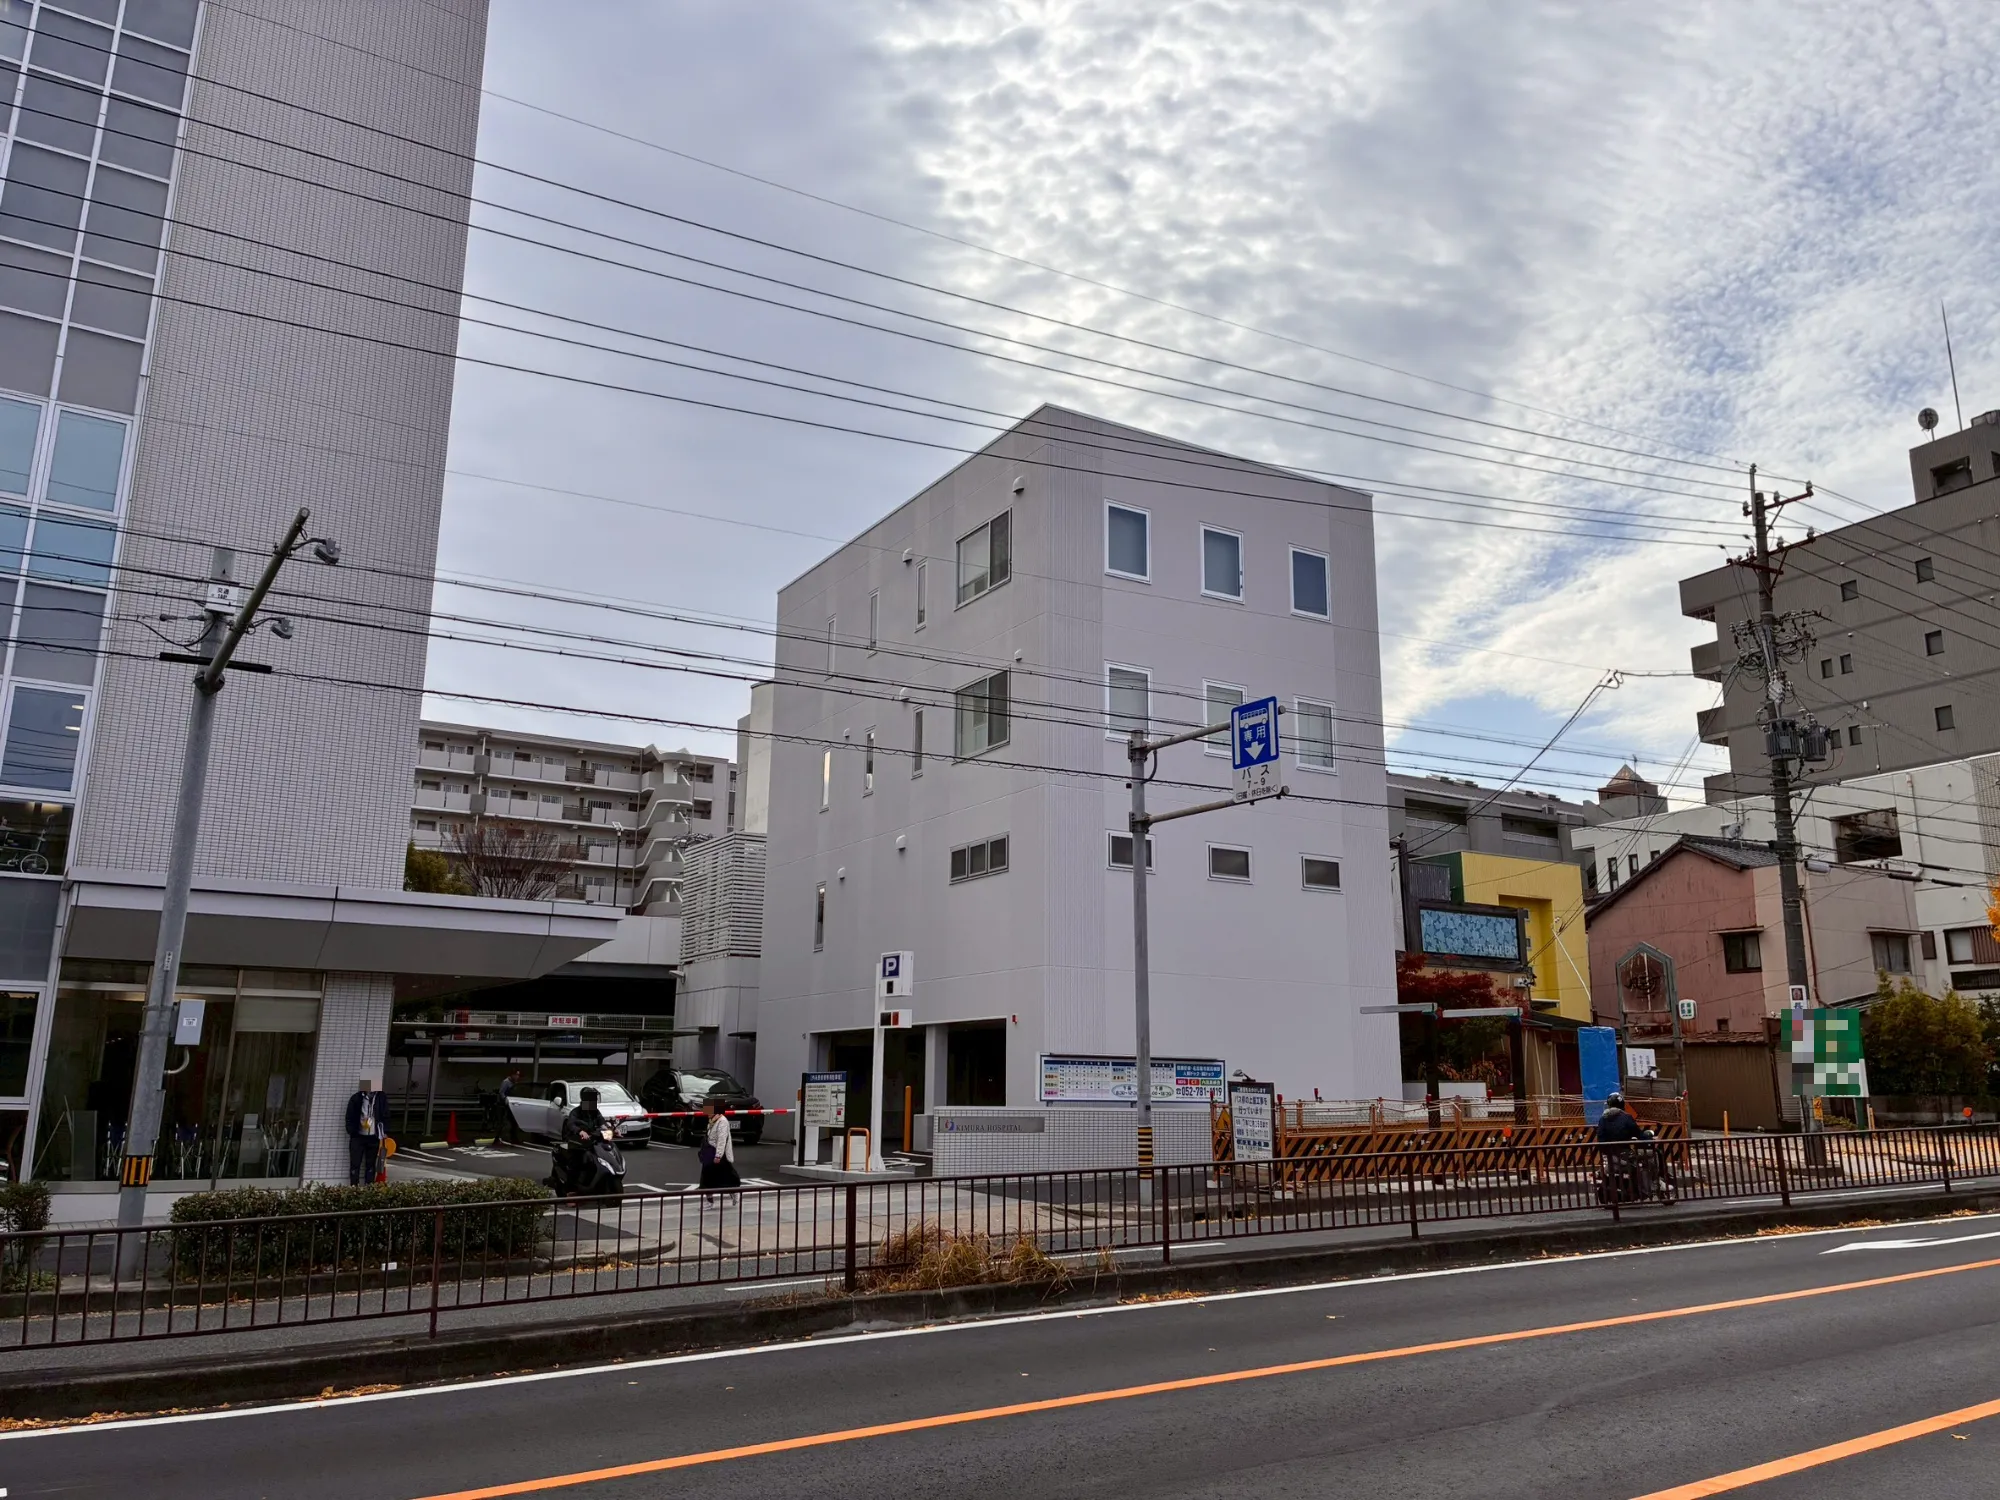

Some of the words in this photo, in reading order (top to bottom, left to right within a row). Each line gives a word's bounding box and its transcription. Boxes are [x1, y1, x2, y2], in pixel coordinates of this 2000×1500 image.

[1244, 725, 1266, 742] 専用
[1242, 764, 1270, 780] バス
[886, 957, 897, 976] P
[956, 1124, 985, 1132] KIMURA
[987, 1124, 1023, 1132] HOSPITAL
